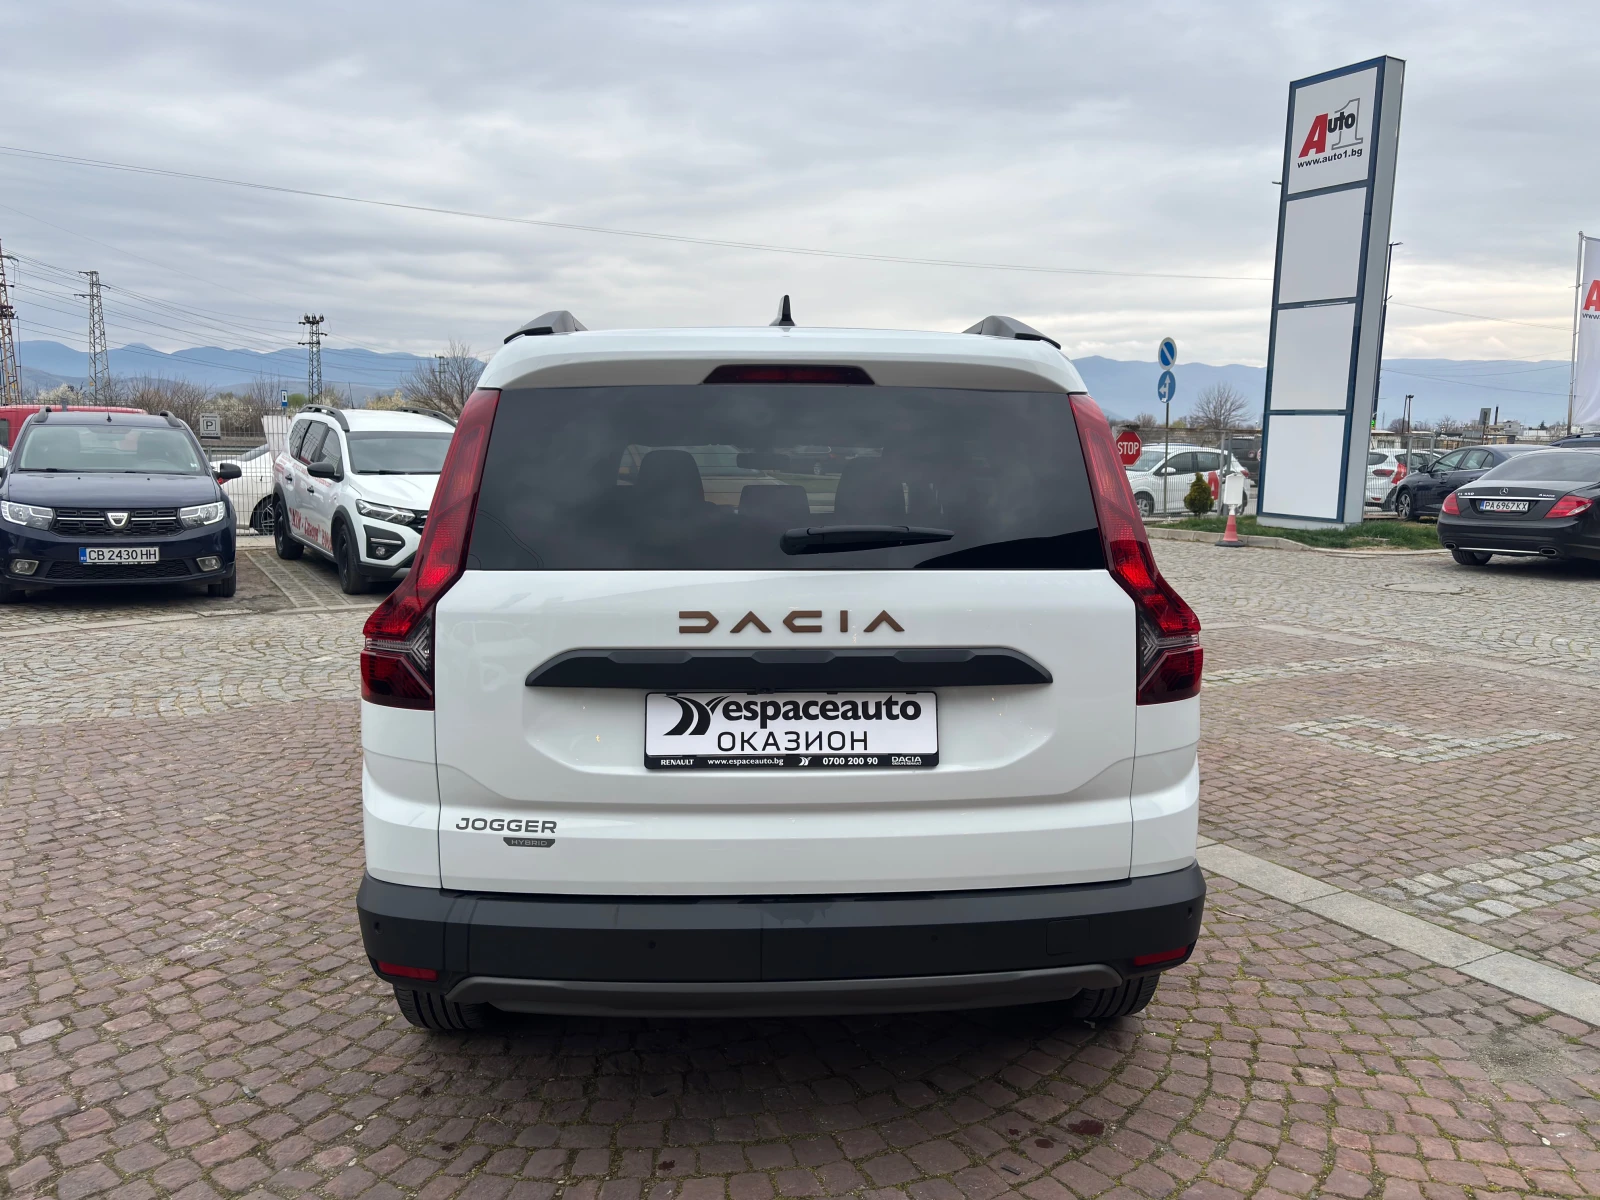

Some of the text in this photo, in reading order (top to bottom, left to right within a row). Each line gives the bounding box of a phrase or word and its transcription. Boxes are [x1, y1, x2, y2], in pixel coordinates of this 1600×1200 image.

[1297, 147, 1363, 168] www.auto1.bg
[205, 420, 214, 430] P
[1117, 441, 1140, 455] STOP
[1484, 501, 1528, 511] PA 6967 KX
[88, 549, 105, 561] CB
[107, 549, 138, 561] 2430
[140, 549, 157, 560] HH
[679, 609, 905, 633] DACIA
[721, 695, 922, 729] espaceauto
[717, 731, 868, 752] ОКАЗИОН
[660, 758, 694, 766] RENAULT
[707, 757, 784, 767] www.espaceauto.bg
[822, 757, 845, 765] 0700
[847, 757, 864, 765] 200
[867, 757, 879, 765] 90
[455, 817, 558, 834] JOGGER
[511, 839, 548, 847] HYBRID
